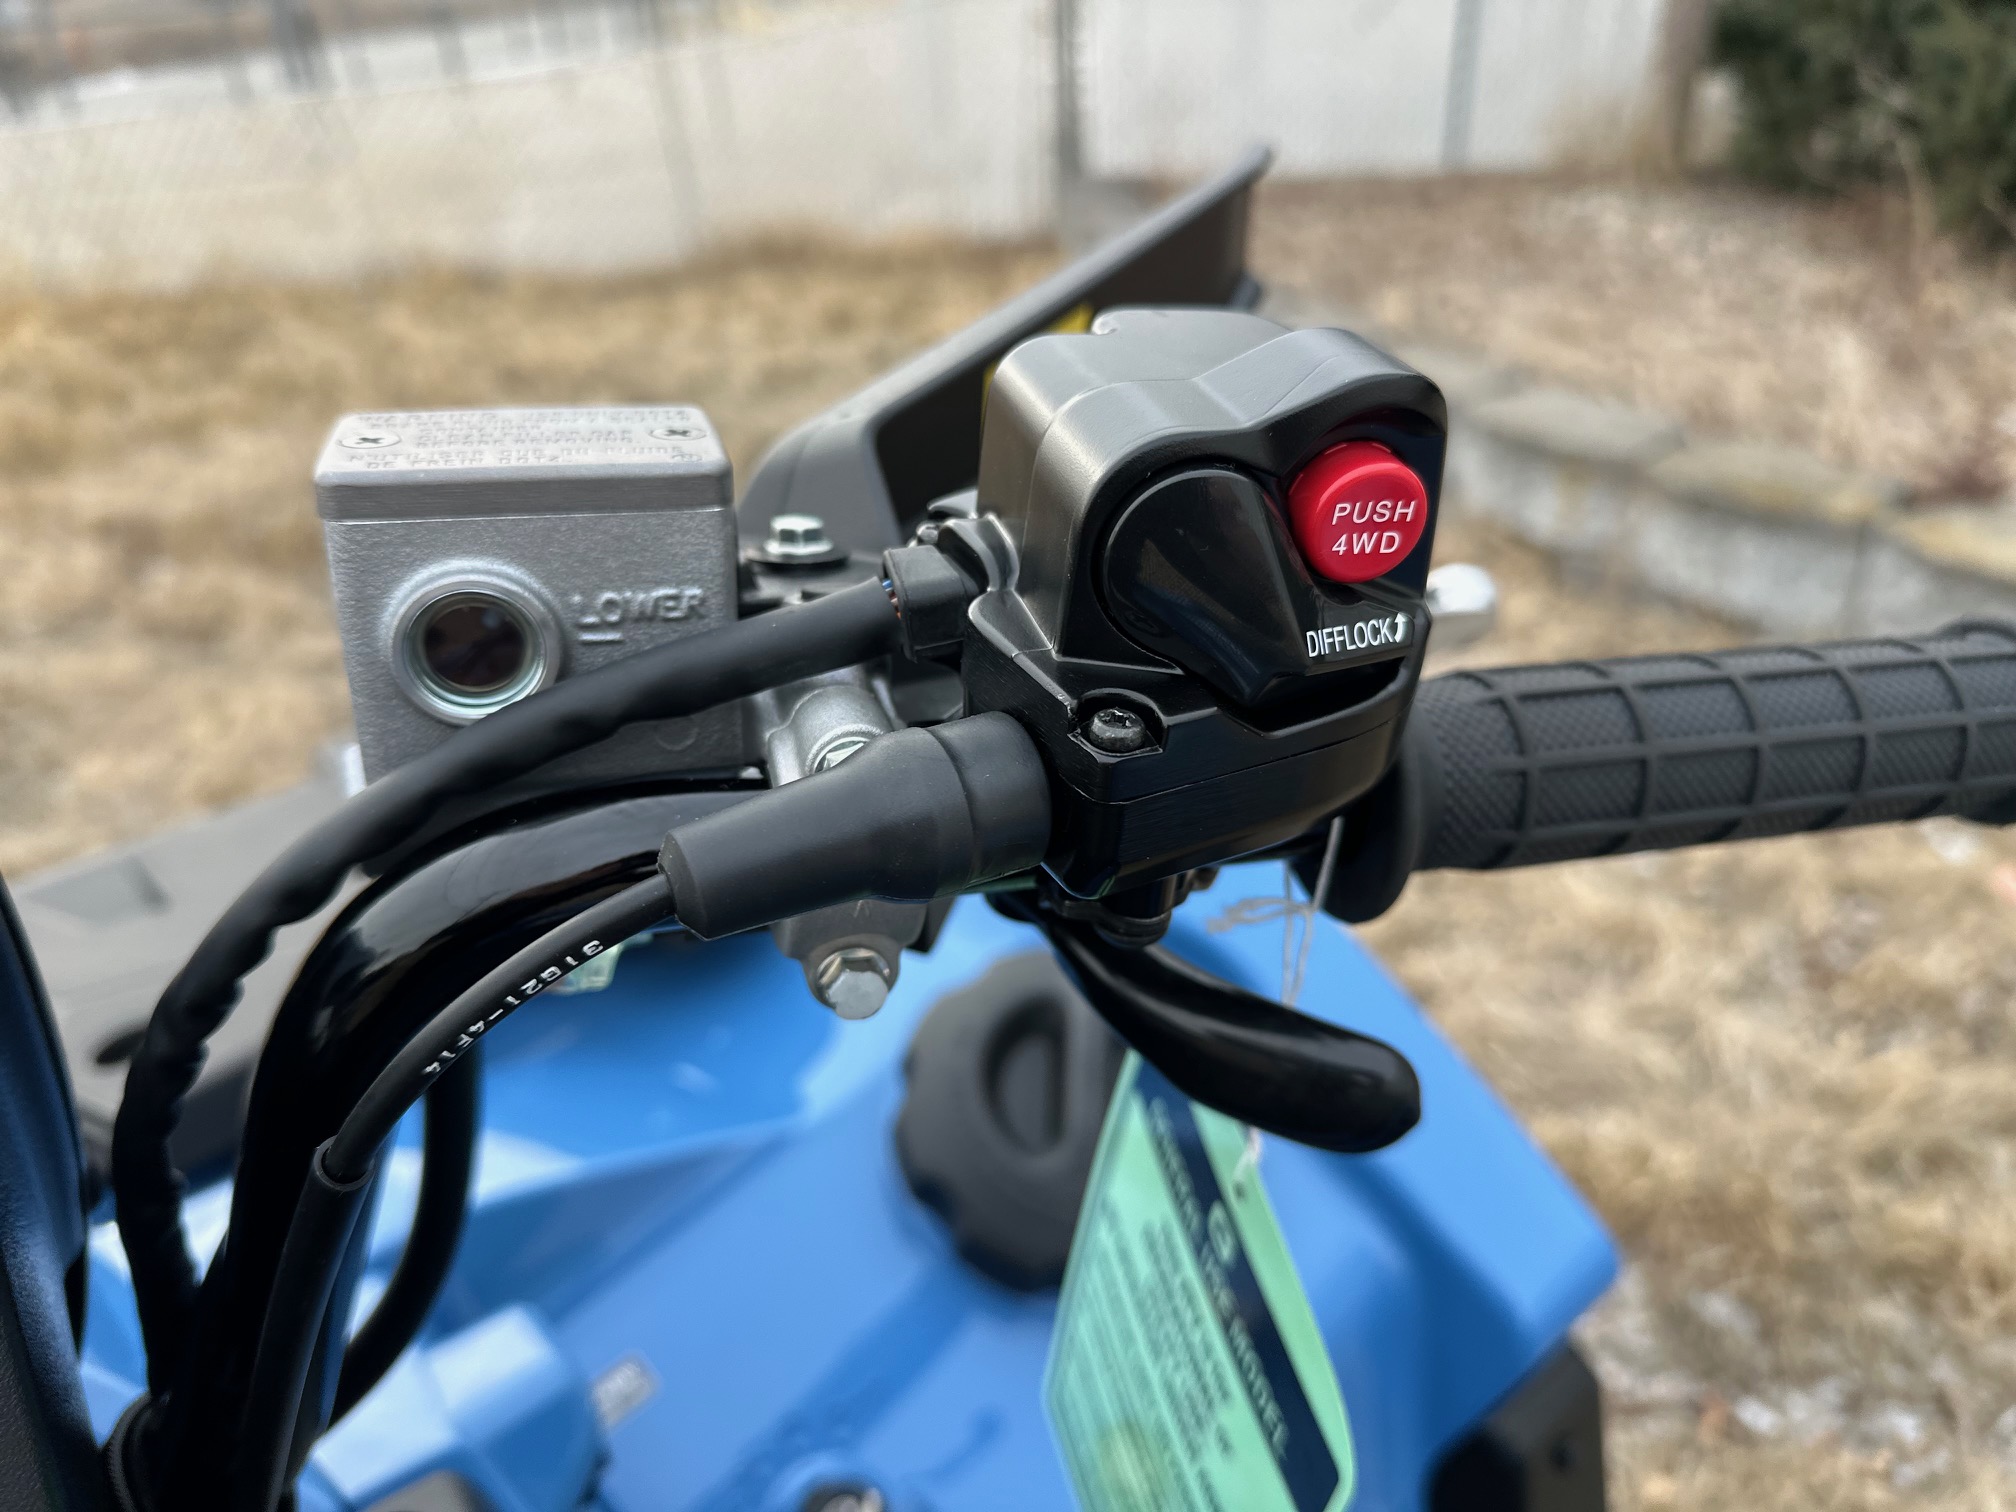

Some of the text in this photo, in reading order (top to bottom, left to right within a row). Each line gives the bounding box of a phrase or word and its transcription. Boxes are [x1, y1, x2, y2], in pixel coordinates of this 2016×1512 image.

[1331, 500, 1416, 526] PUSH
[1331, 531, 1401, 556] 4WD
[572, 587, 705, 628] LOWER
[1305, 616, 1394, 658] DIFFLOCK
